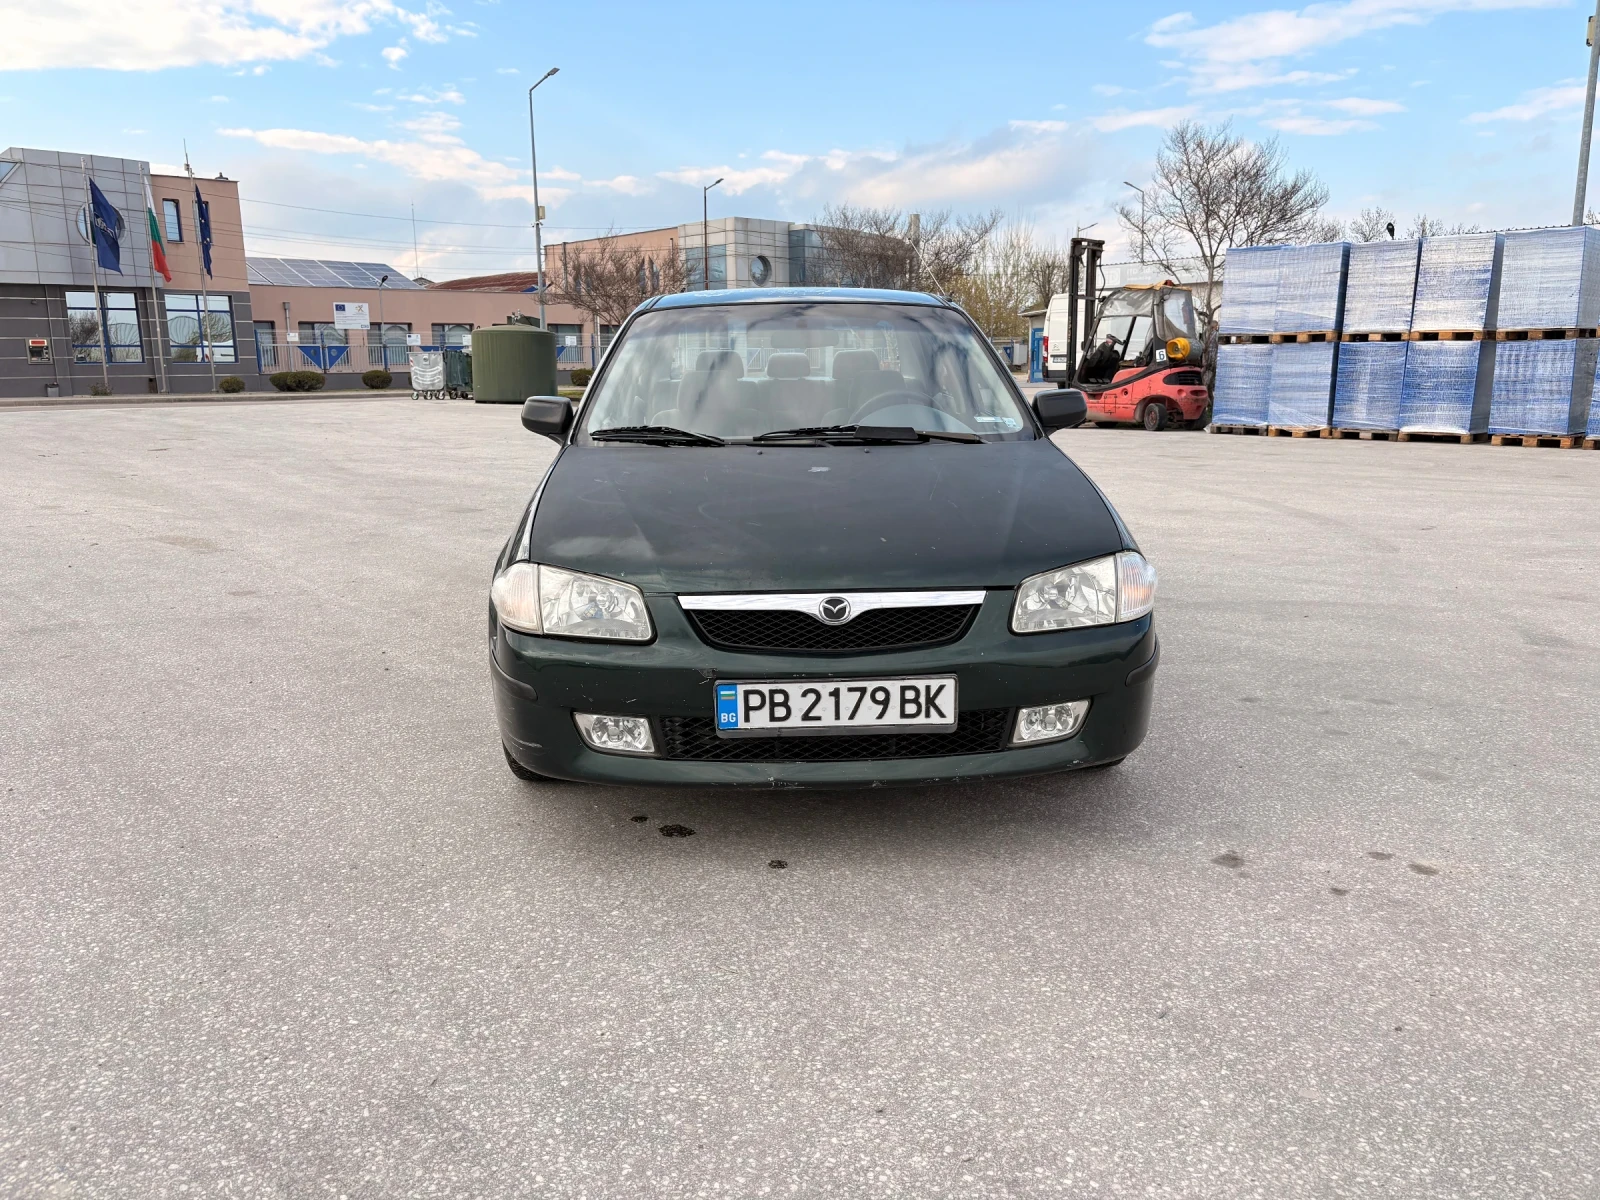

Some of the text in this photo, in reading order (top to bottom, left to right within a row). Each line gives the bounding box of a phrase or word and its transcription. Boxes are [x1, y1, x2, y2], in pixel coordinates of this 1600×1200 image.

[1158, 350, 1165, 361] 6
[742, 683, 947, 723] PB 2179 BK
[720, 712, 736, 723] BG
